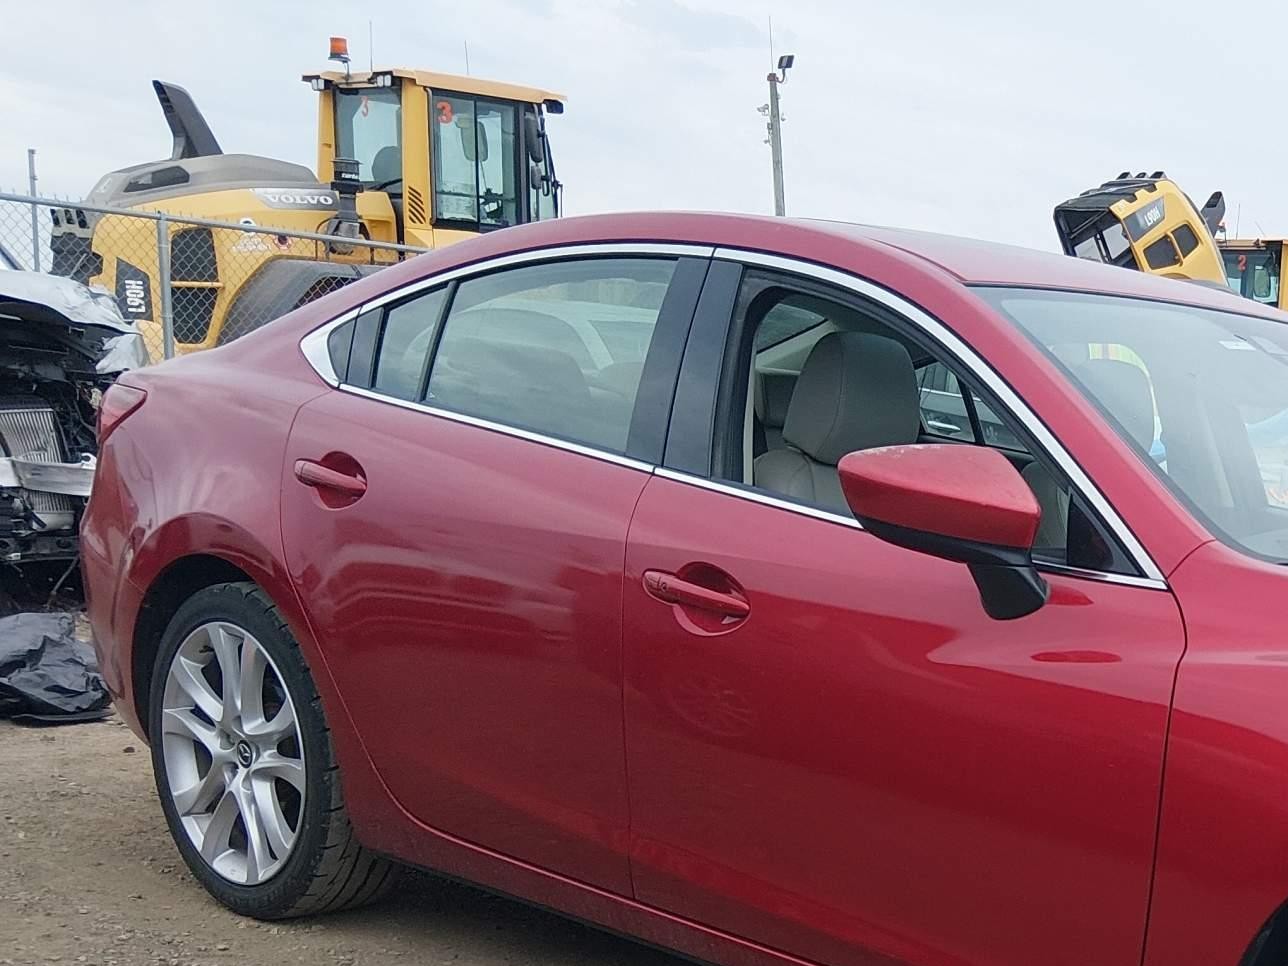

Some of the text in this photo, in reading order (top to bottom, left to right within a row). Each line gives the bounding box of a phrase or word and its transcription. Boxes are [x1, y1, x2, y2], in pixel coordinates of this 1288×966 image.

[436, 101, 452, 124] 3
[264, 194, 333, 205] VOLVO
[124, 279, 146, 313] L90H
